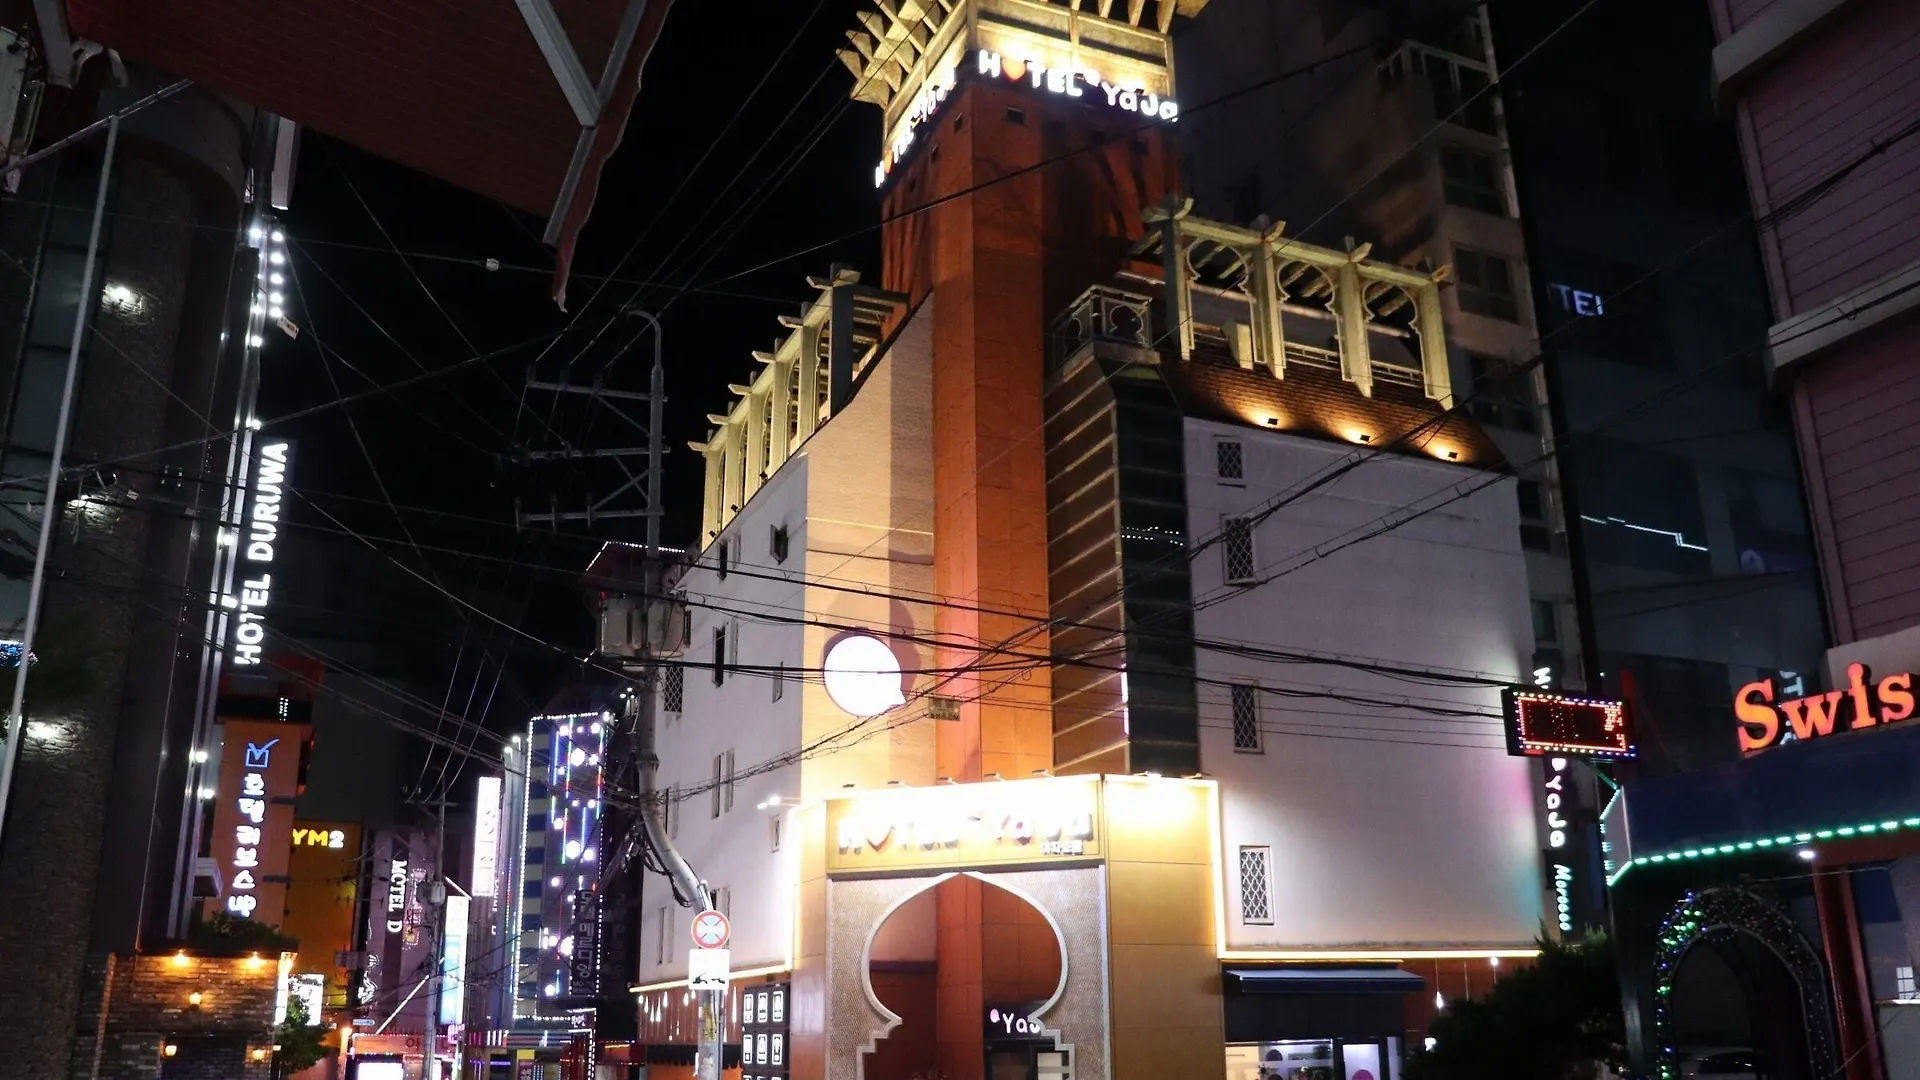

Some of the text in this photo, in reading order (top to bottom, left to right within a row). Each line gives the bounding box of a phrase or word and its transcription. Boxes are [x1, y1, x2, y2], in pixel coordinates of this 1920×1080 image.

[234, 441, 288, 664] HOTEL DURUWA
[386, 859, 408, 933] MOTEL D
